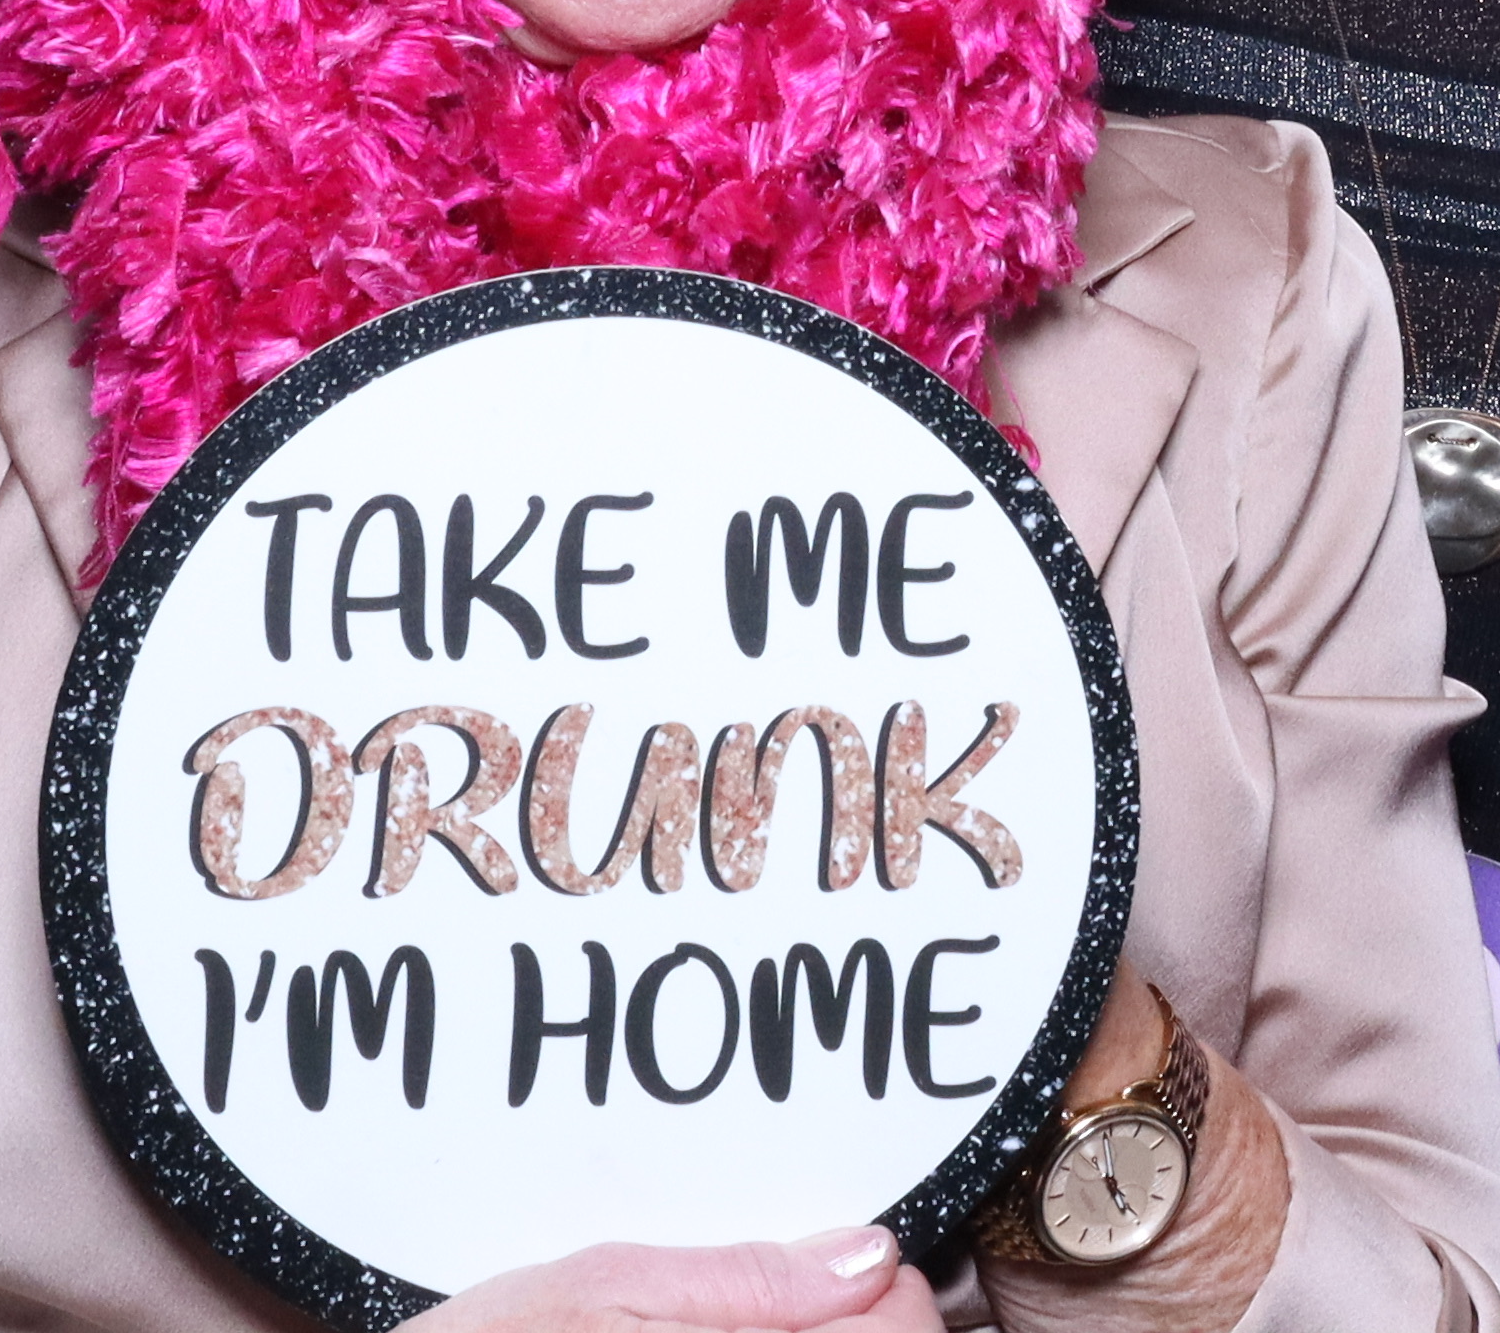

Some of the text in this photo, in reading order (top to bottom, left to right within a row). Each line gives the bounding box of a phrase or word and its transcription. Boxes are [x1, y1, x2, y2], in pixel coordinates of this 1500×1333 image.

[244, 489, 975, 663] TAKE ME
[182, 699, 1023, 901] DRUNK
[194, 934, 1001, 1114] I'M HOME
